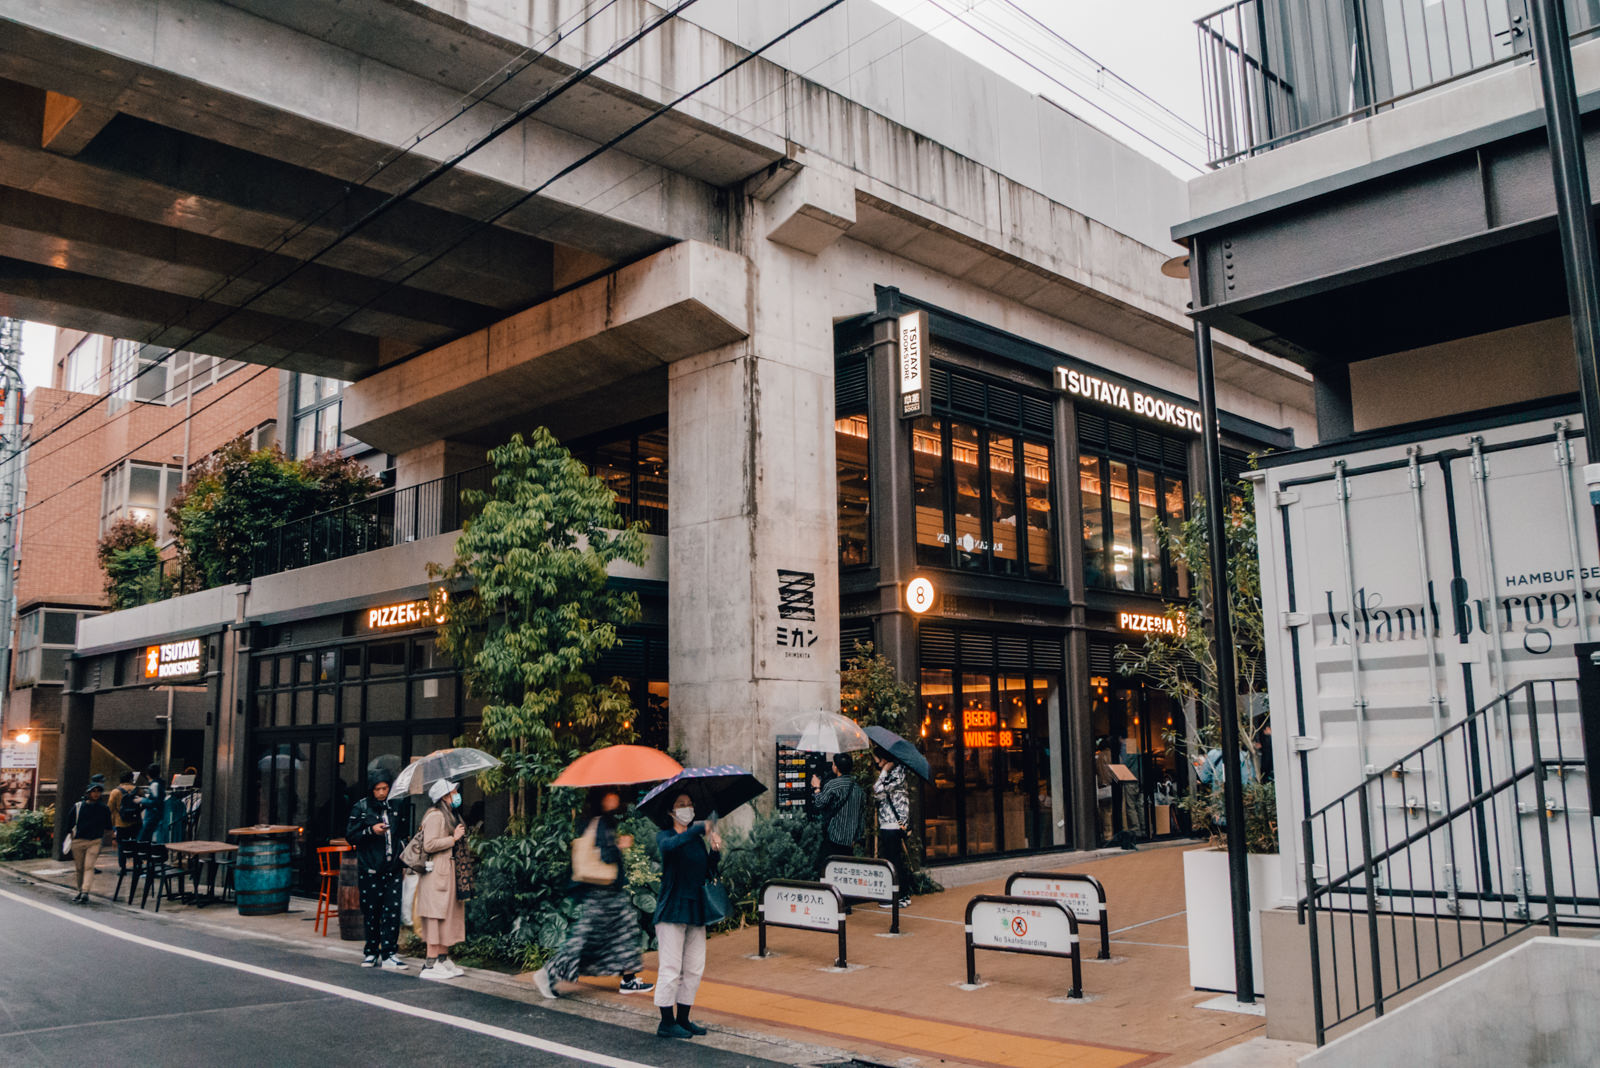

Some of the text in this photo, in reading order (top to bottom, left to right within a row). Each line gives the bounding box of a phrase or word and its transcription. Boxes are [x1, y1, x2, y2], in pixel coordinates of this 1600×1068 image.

[902, 328, 910, 381] BOOKSTORE
[909, 327, 918, 379] TSUTAYA
[1056, 366, 1220, 438] TSUTAYA BOOKSTO
[916, 586, 925, 604] 8
[1120, 612, 1174, 634] PIZZERIA
[1324, 576, 1600, 655] Island Burger
[776, 626, 818, 648] ミカン
[160, 639, 200, 662] TSUTAYA
[963, 731, 993, 748] WINE
[776, 892, 824, 905] バイク乗り入れ
[993, 935, 1048, 948] No Skateboarding
